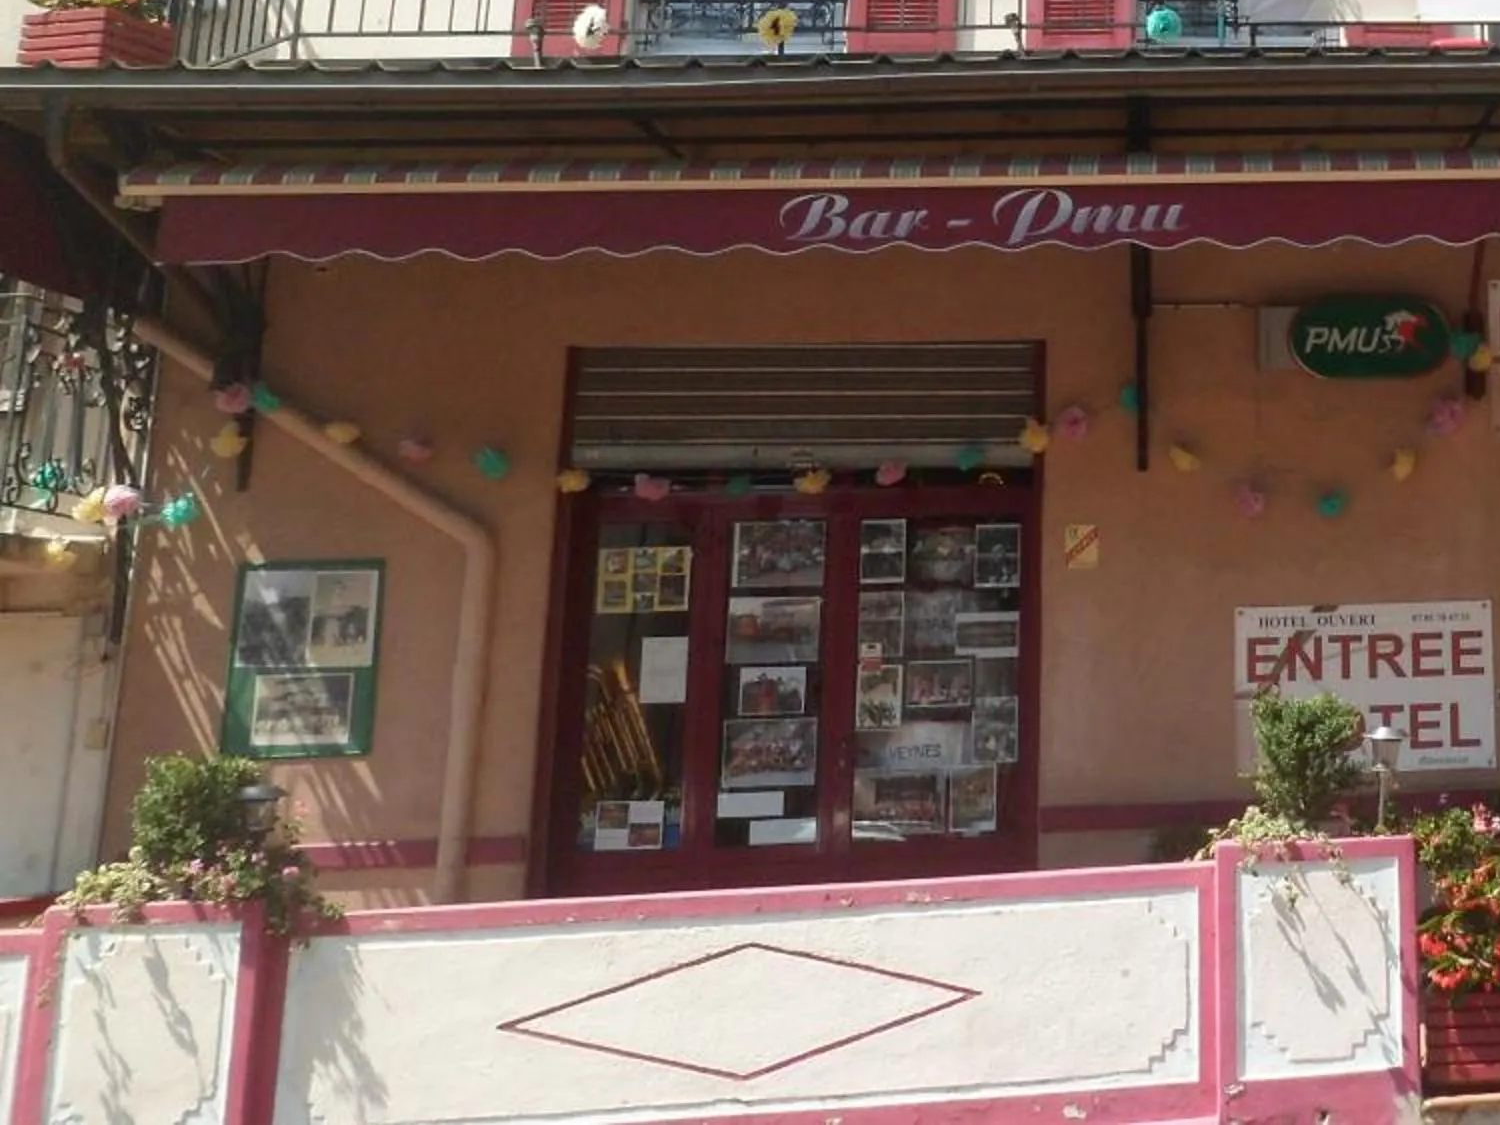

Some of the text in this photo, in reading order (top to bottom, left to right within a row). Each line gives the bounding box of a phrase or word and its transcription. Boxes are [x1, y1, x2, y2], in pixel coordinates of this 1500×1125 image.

[779, 192, 930, 243] Bar
[992, 187, 1190, 245] Pmu
[1304, 327, 1382, 354] PMU
[1258, 615, 1308, 628] HOTEL
[1247, 630, 1485, 683] ENTREE
